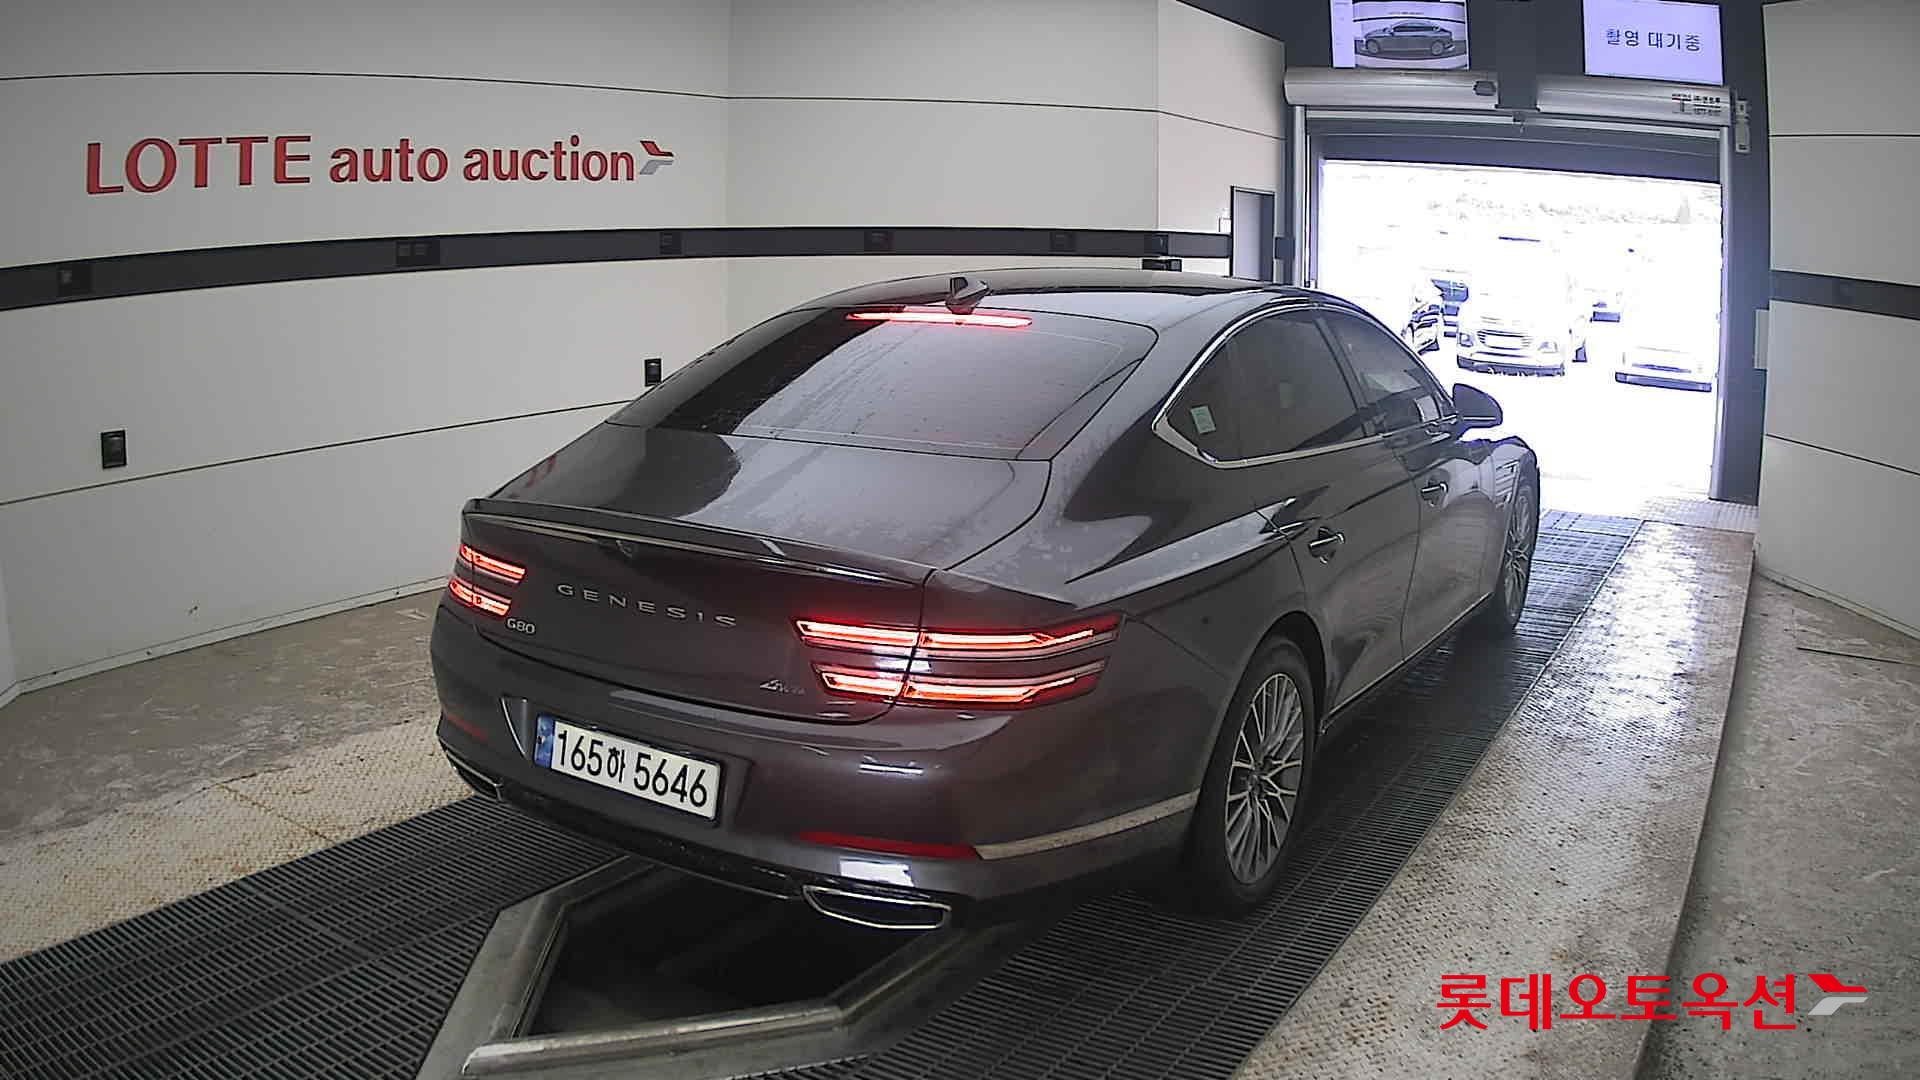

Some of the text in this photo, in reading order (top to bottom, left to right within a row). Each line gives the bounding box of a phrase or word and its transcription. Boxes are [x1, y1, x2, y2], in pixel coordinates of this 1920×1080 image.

[1647, 31, 1700, 52] 대기중
[87, 134, 635, 195] LOTTE auto auction
[506, 617, 536, 635] G80
[557, 584, 737, 628] GENESIS
[557, 730, 708, 808] 165하 5646
